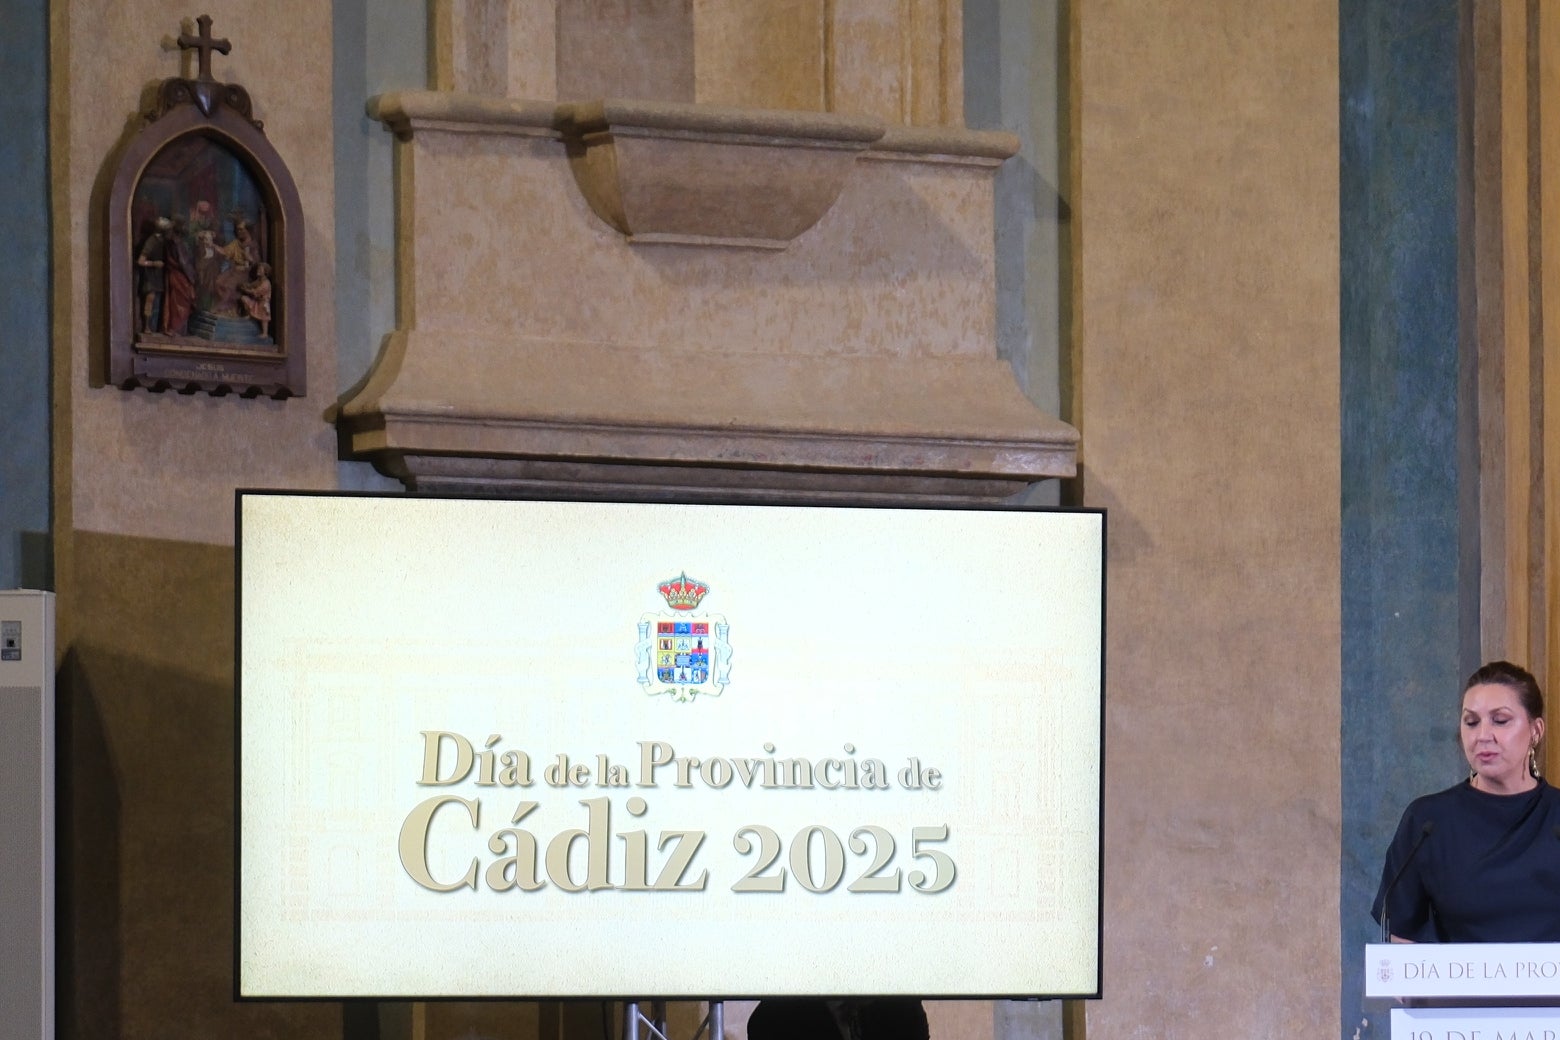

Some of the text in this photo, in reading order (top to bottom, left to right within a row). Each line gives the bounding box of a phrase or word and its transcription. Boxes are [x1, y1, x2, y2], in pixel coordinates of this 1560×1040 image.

[416, 729, 943, 788] Día de la Provincia de
[398, 794, 956, 894] Cádiz 2025
[1404, 959, 1440, 980] DÍA
[1449, 961, 1475, 979] DE
[1484, 961, 1508, 979] LA
